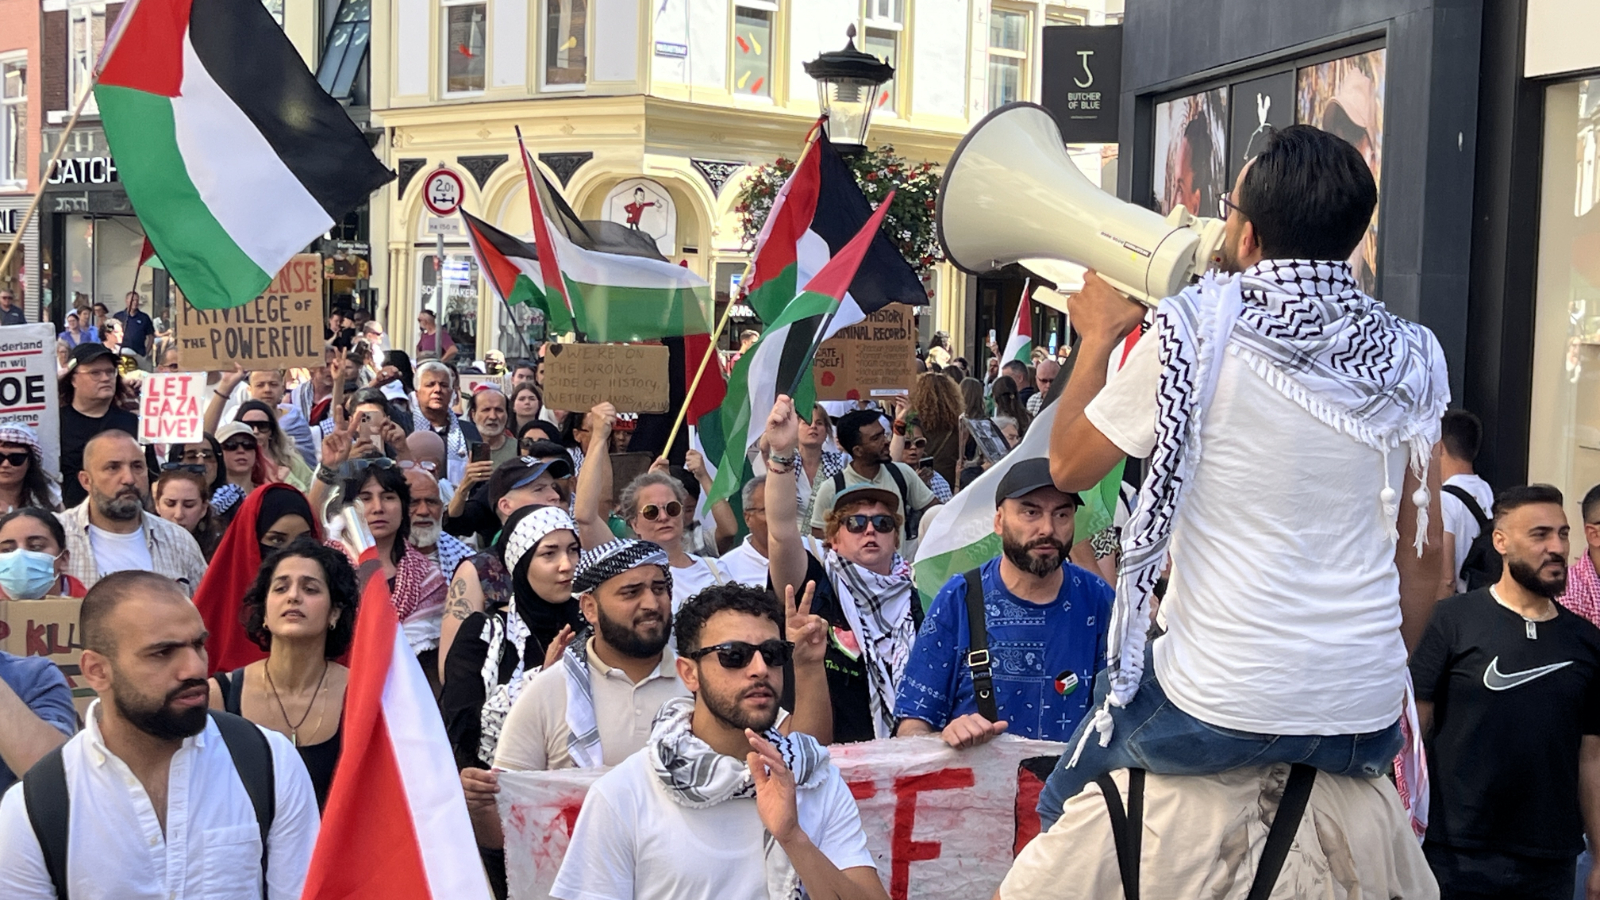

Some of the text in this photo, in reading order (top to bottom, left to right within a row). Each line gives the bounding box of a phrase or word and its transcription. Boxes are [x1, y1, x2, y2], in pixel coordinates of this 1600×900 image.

[1067, 92, 1102, 101] BUTCHER
[1068, 101, 1101, 109] OF BLUE
[294, 299, 312, 311] OF
[0, 340, 43, 352] derland
[182, 325, 319, 360] THE POWERFUL
[10, 358, 27, 368] wij
[548, 362, 637, 375] THE WRONG
[148, 376, 193, 396] LET
[549, 378, 580, 388] SIDE
[583, 378, 602, 390] OF
[145, 396, 199, 416] GAZA
[144, 417, 198, 438] LIVE!
